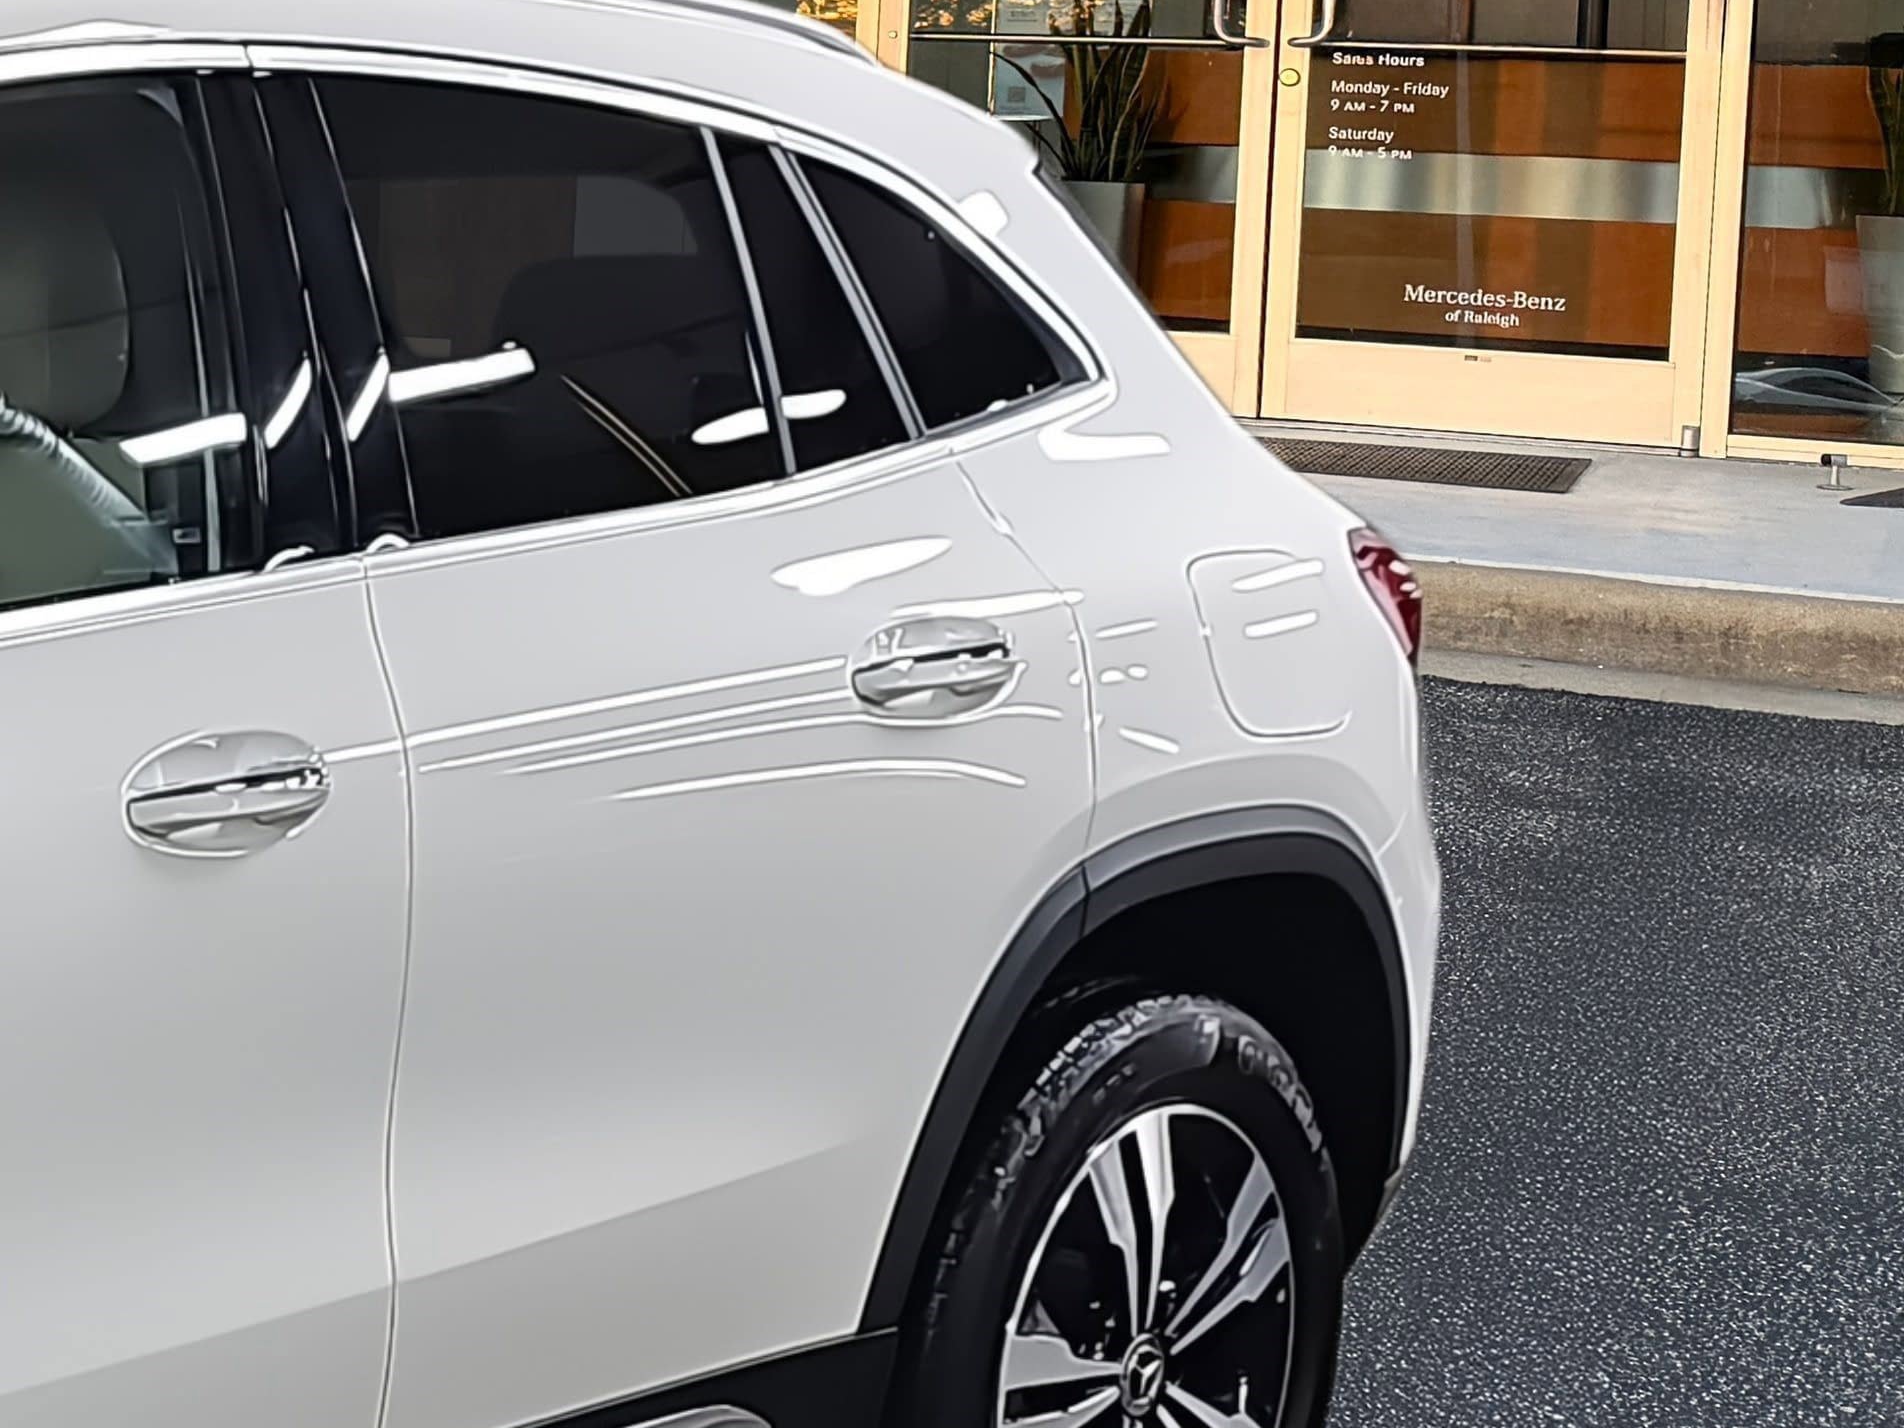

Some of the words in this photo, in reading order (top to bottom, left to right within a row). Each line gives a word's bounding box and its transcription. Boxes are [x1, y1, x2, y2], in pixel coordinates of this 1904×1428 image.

[1378, 53, 1425, 67] Hours
[1331, 80, 1390, 97] Monday
[1403, 82, 1449, 99] Friday
[1330, 99, 1340, 111] 9
[1344, 102, 1366, 111] AM
[1379, 100, 1390, 112] 7
[1393, 103, 1415, 113] PM
[1328, 126, 1394, 144] Saturday
[1328, 145, 1338, 157] 9
[1342, 148, 1363, 158] AM
[1377, 147, 1387, 159] 5
[1391, 149, 1412, 160] PM
[1403, 284, 1566, 312] Mercedes-Benz
[1445, 310, 1462, 322] of
[1464, 310, 1520, 328] Raleigh
